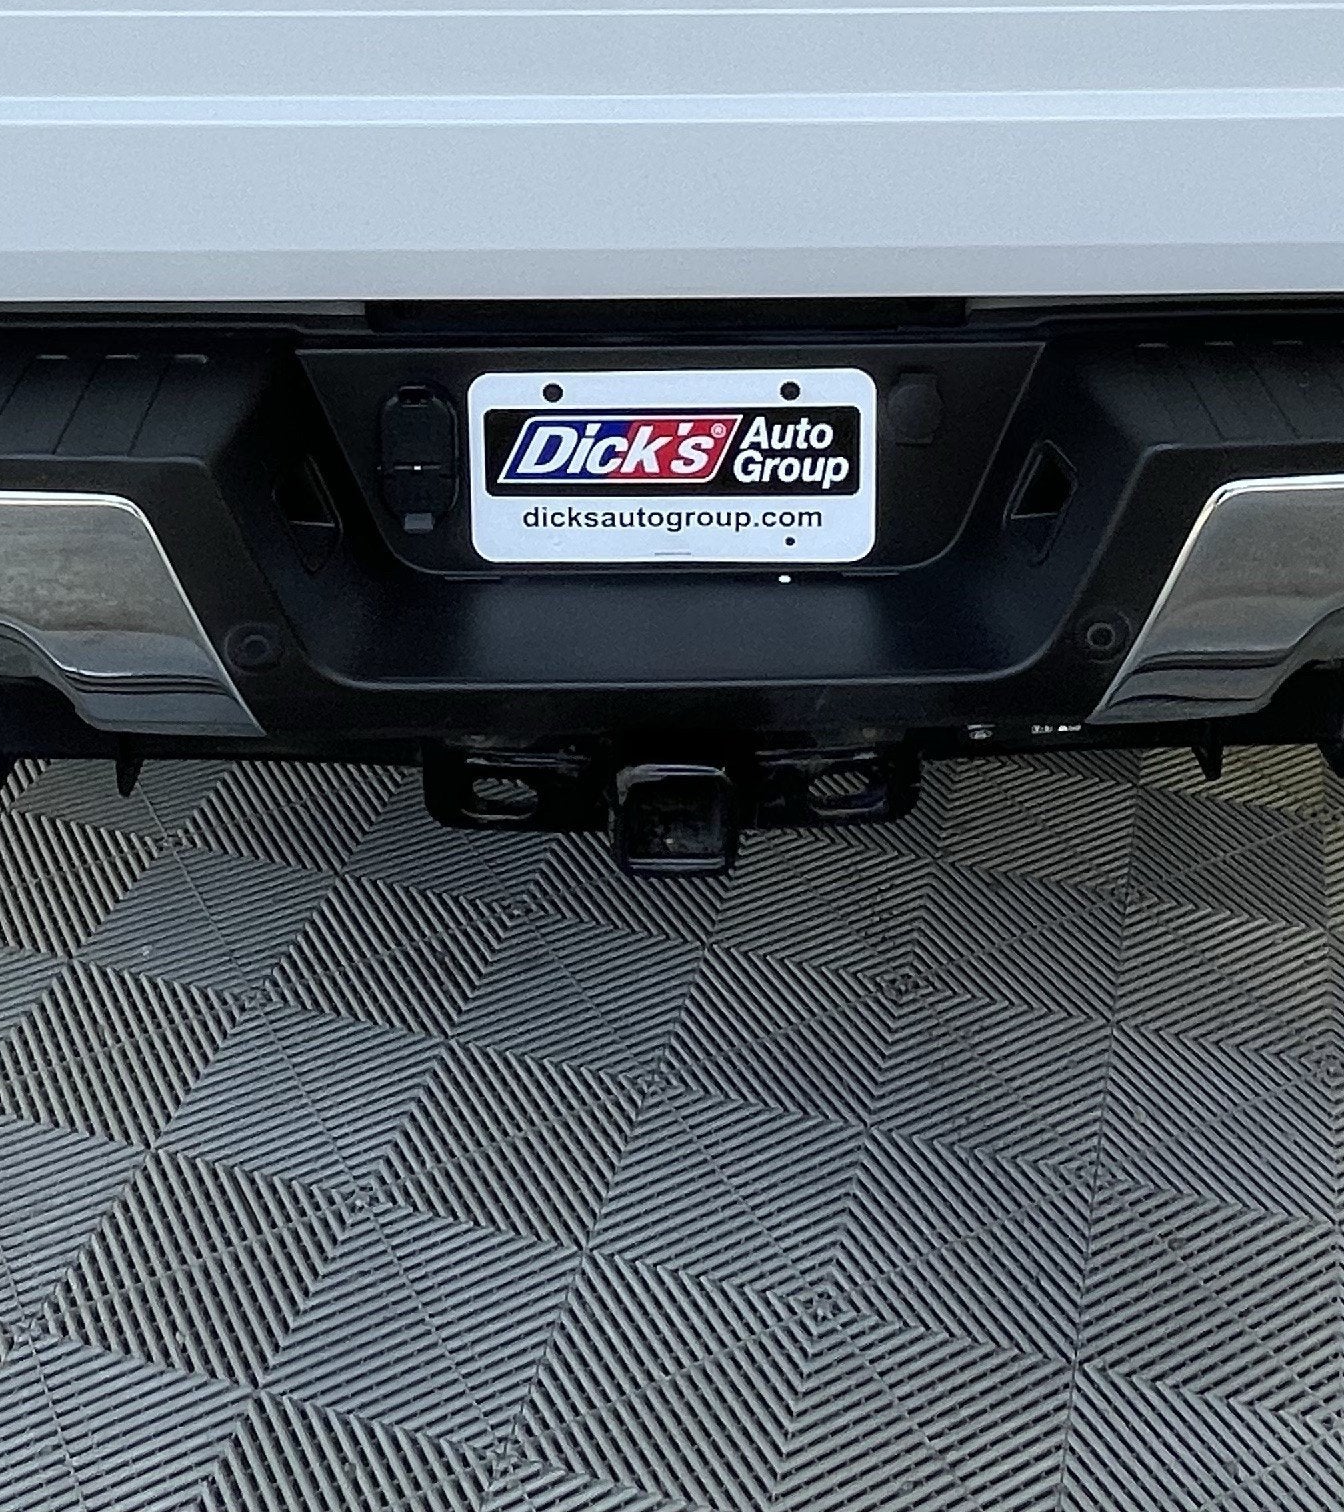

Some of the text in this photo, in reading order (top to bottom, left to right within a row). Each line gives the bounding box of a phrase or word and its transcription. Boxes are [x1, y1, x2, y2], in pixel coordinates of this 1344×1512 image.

[740, 416, 833, 450] Auto
[733, 451, 850, 489] Group
[522, 506, 823, 531] dicksautogroup.com
